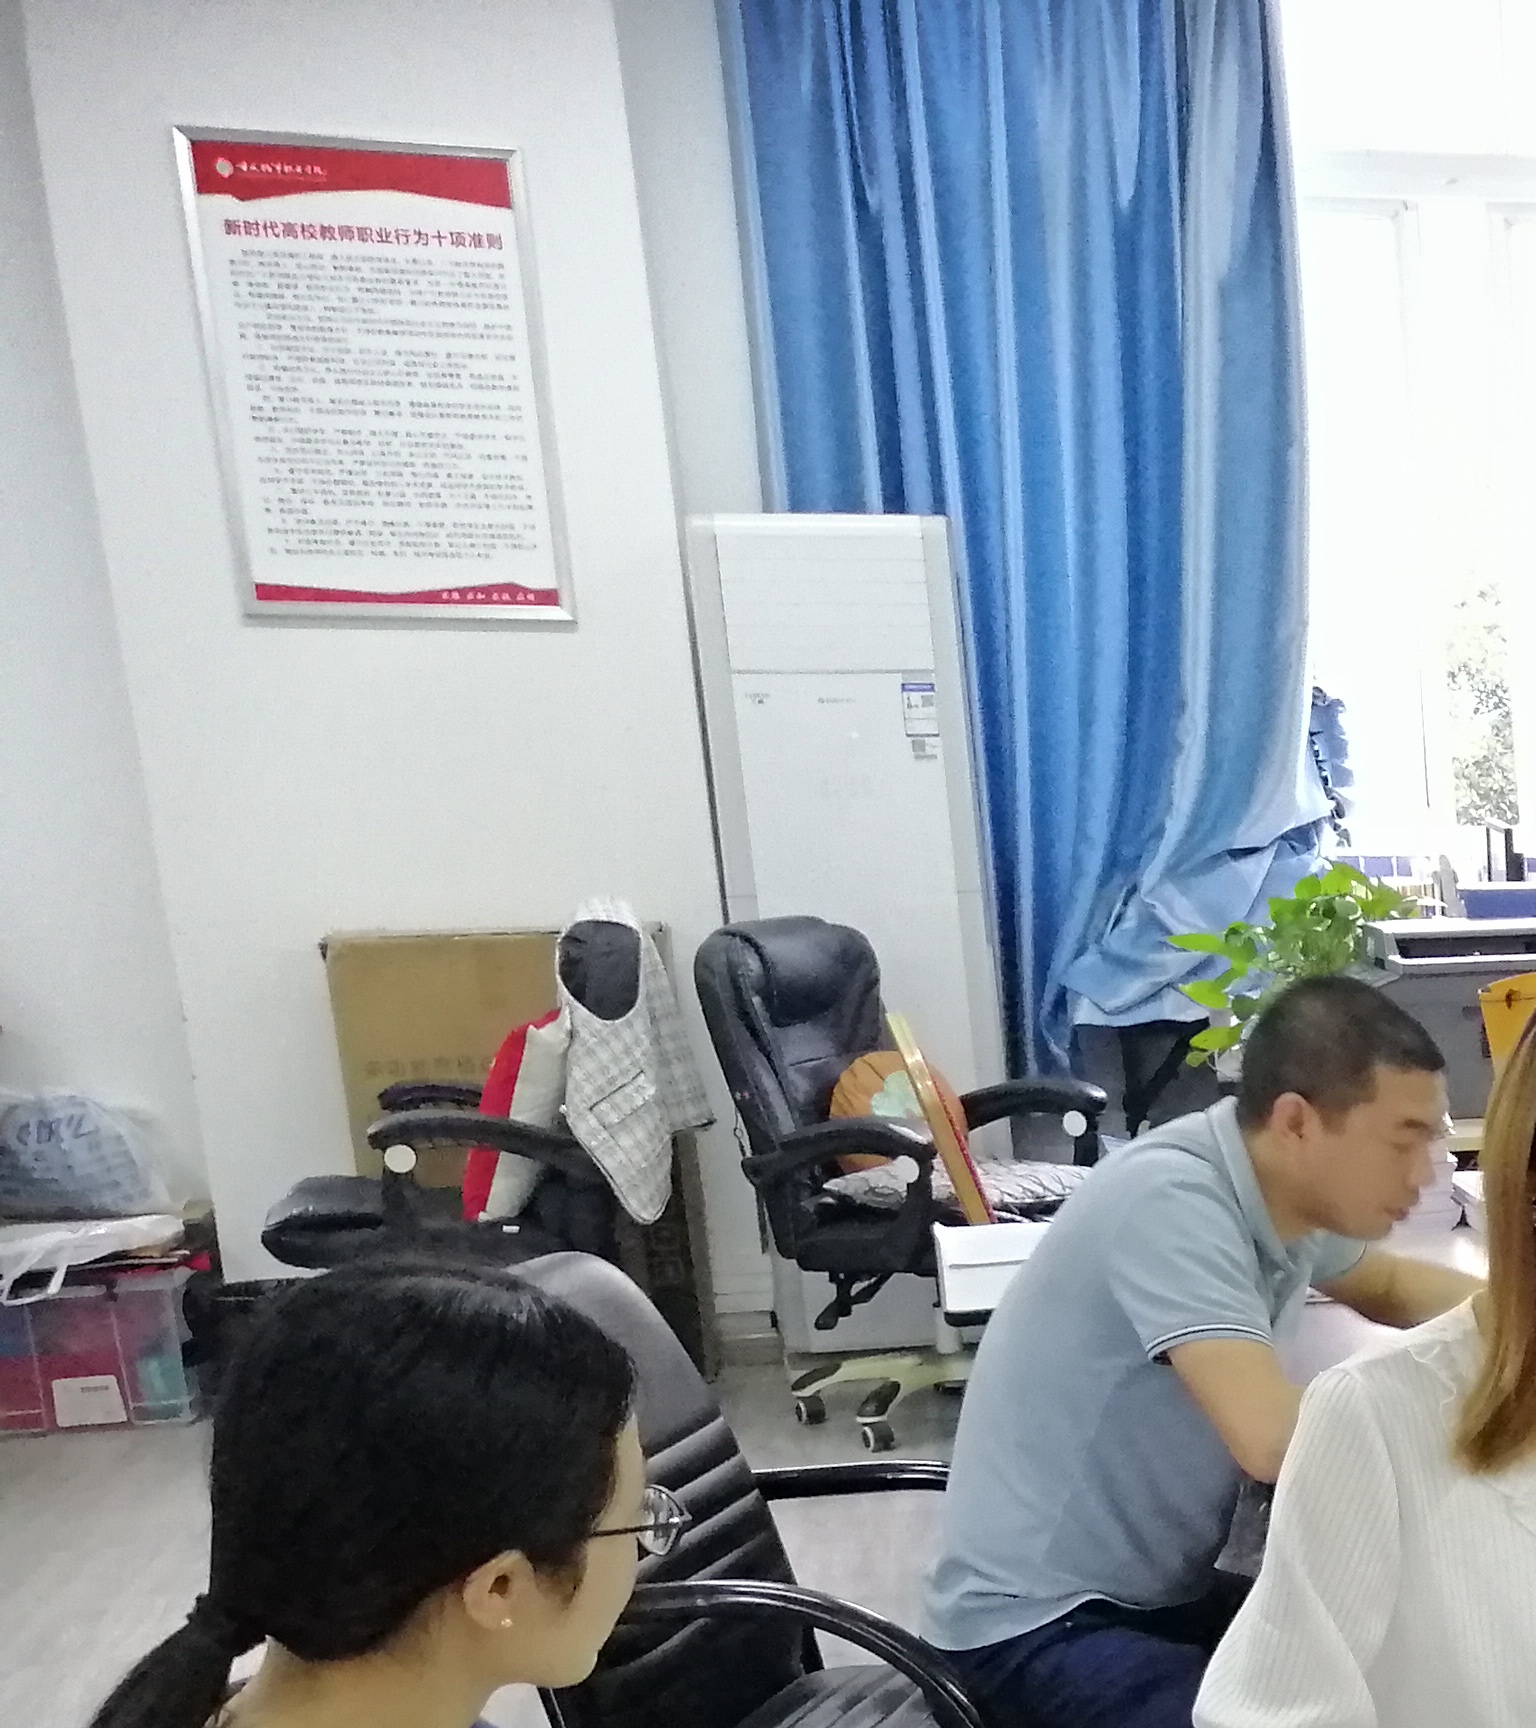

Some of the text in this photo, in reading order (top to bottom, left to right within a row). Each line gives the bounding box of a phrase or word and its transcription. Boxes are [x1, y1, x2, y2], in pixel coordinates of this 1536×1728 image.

[224, 219, 503, 250] 新时代高校教师职业行为十项准则
